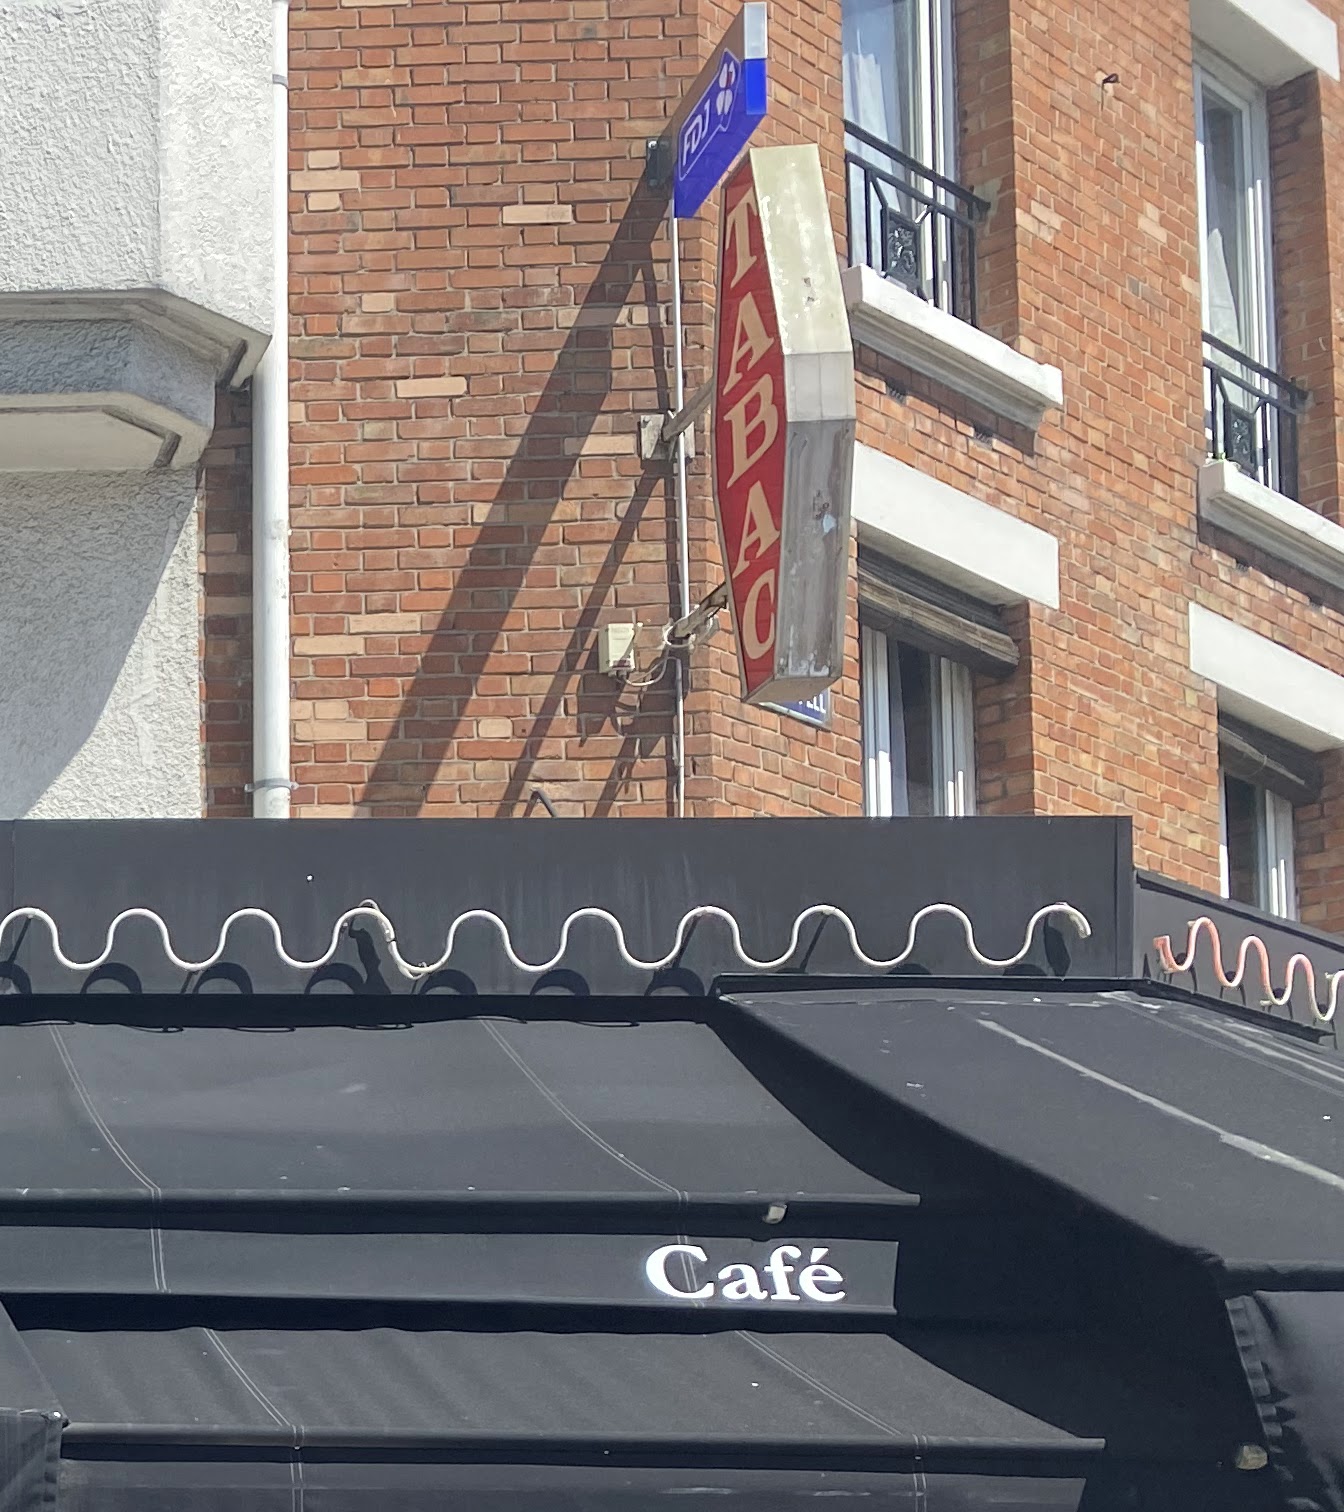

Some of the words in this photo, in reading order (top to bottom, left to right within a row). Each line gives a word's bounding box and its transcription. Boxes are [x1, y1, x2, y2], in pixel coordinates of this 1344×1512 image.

[680, 97, 714, 169] FDJ
[721, 186, 780, 660] TABAC
[645, 1244, 847, 1304] Café
